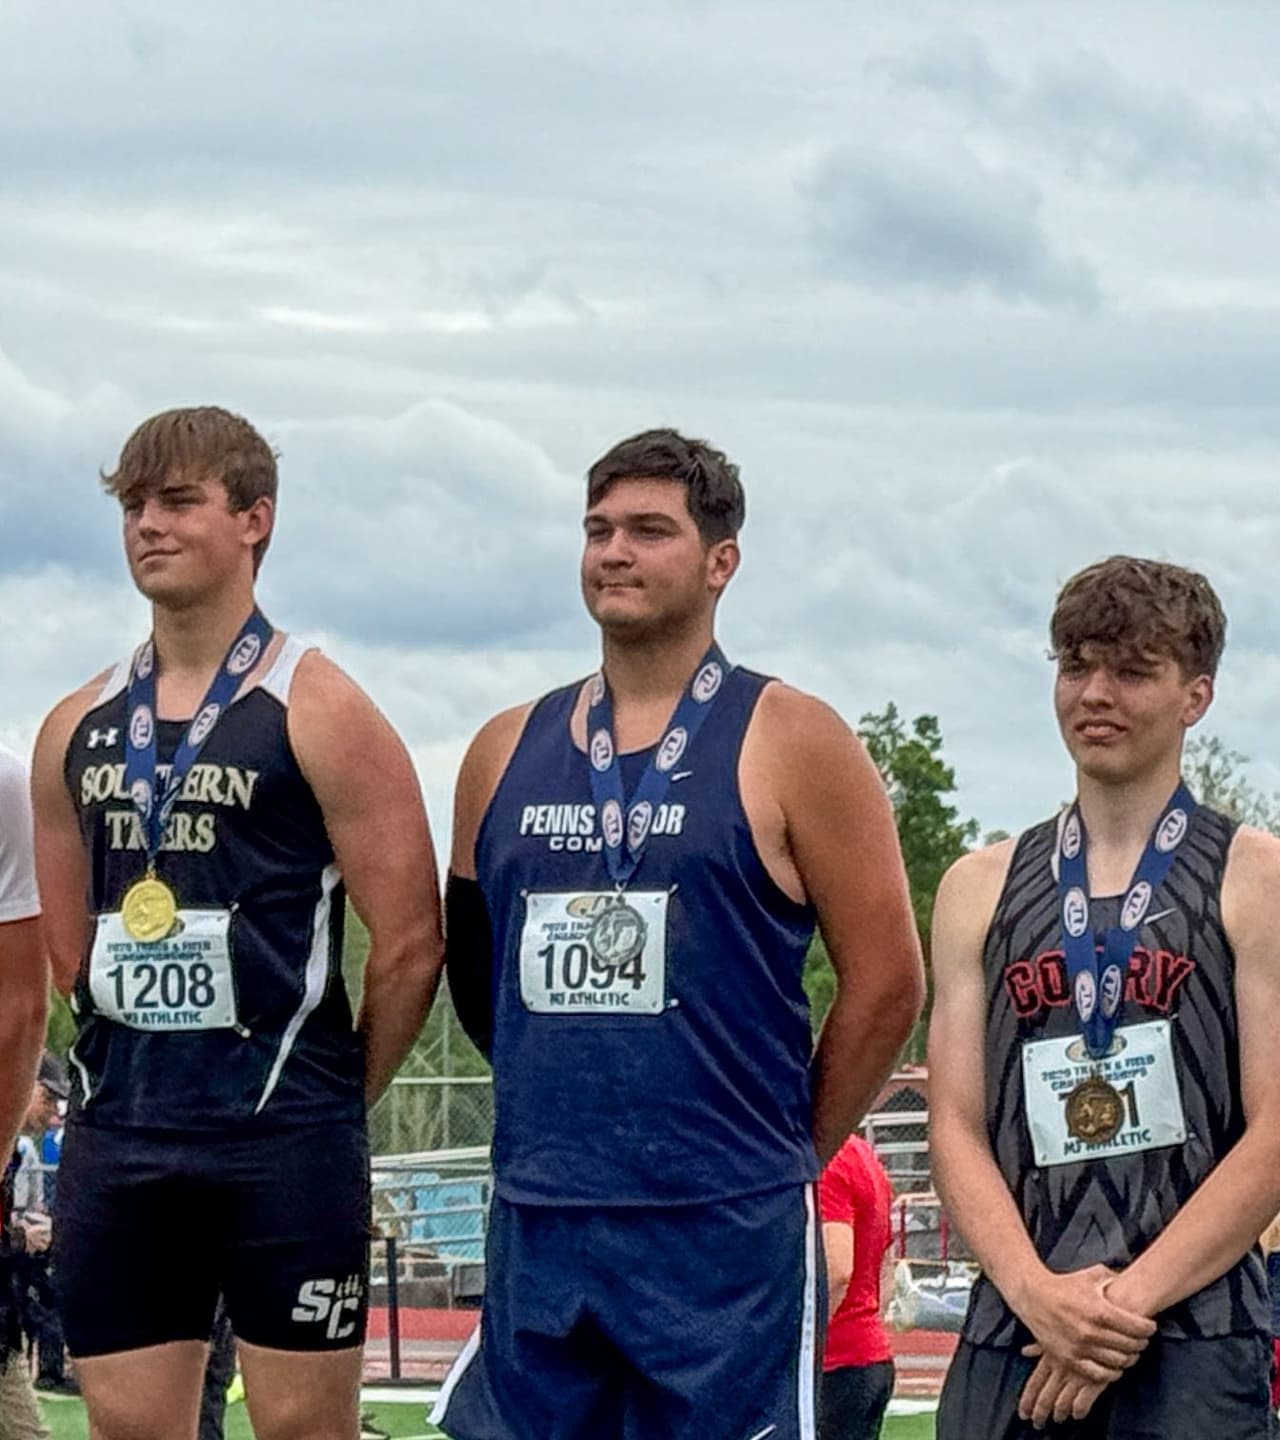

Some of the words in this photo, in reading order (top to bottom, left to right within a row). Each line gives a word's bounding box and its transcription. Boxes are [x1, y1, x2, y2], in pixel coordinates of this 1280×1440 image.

[106, 963, 216, 1010] 1208
[537, 943, 646, 990] 1094
[1004, 945, 1195, 1017] CORY
[141, 1011, 203, 1024] ATHLETIC
[568, 991, 630, 1006] ATHLETIC
